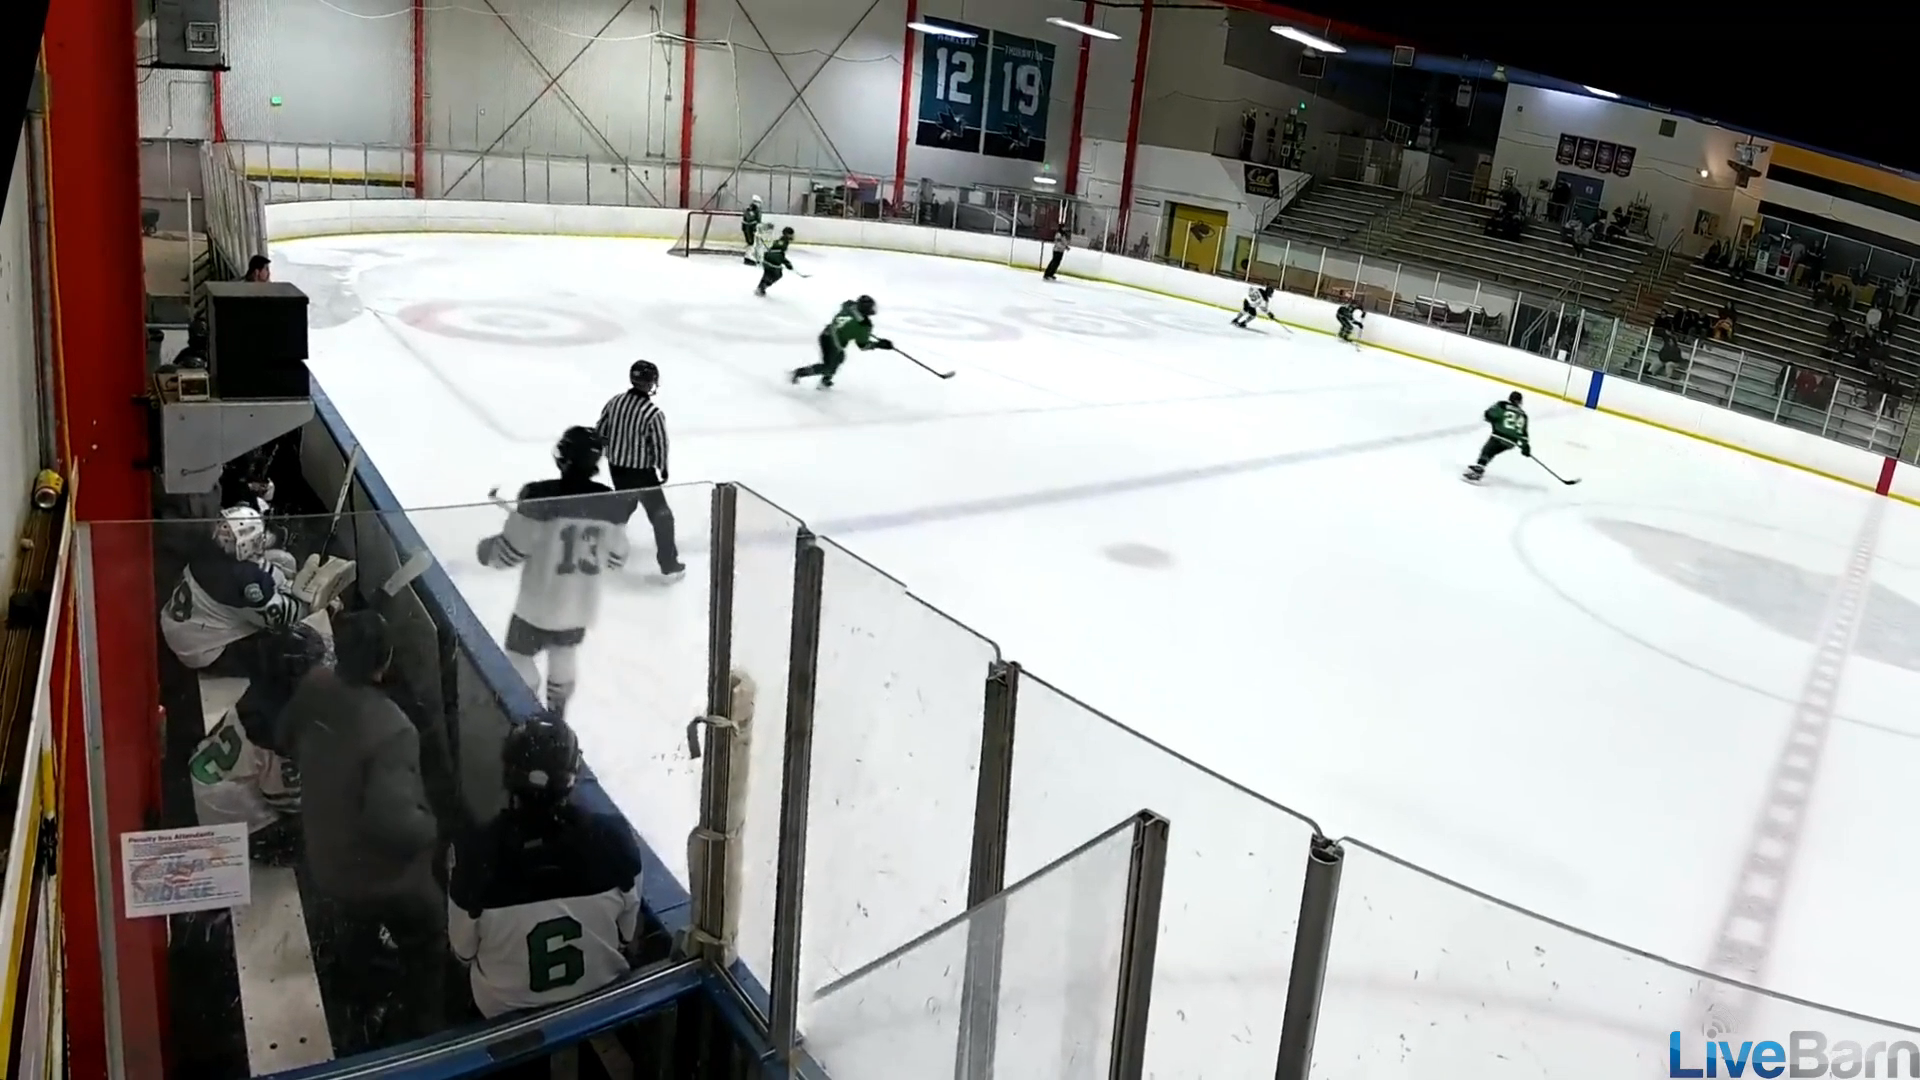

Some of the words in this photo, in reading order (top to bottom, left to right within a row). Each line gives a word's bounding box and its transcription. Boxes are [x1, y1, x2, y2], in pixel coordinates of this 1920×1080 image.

[936, 47, 974, 104] 12
[1002, 61, 1041, 116] 19
[557, 523, 603, 576] 13
[527, 916, 585, 993] 6
